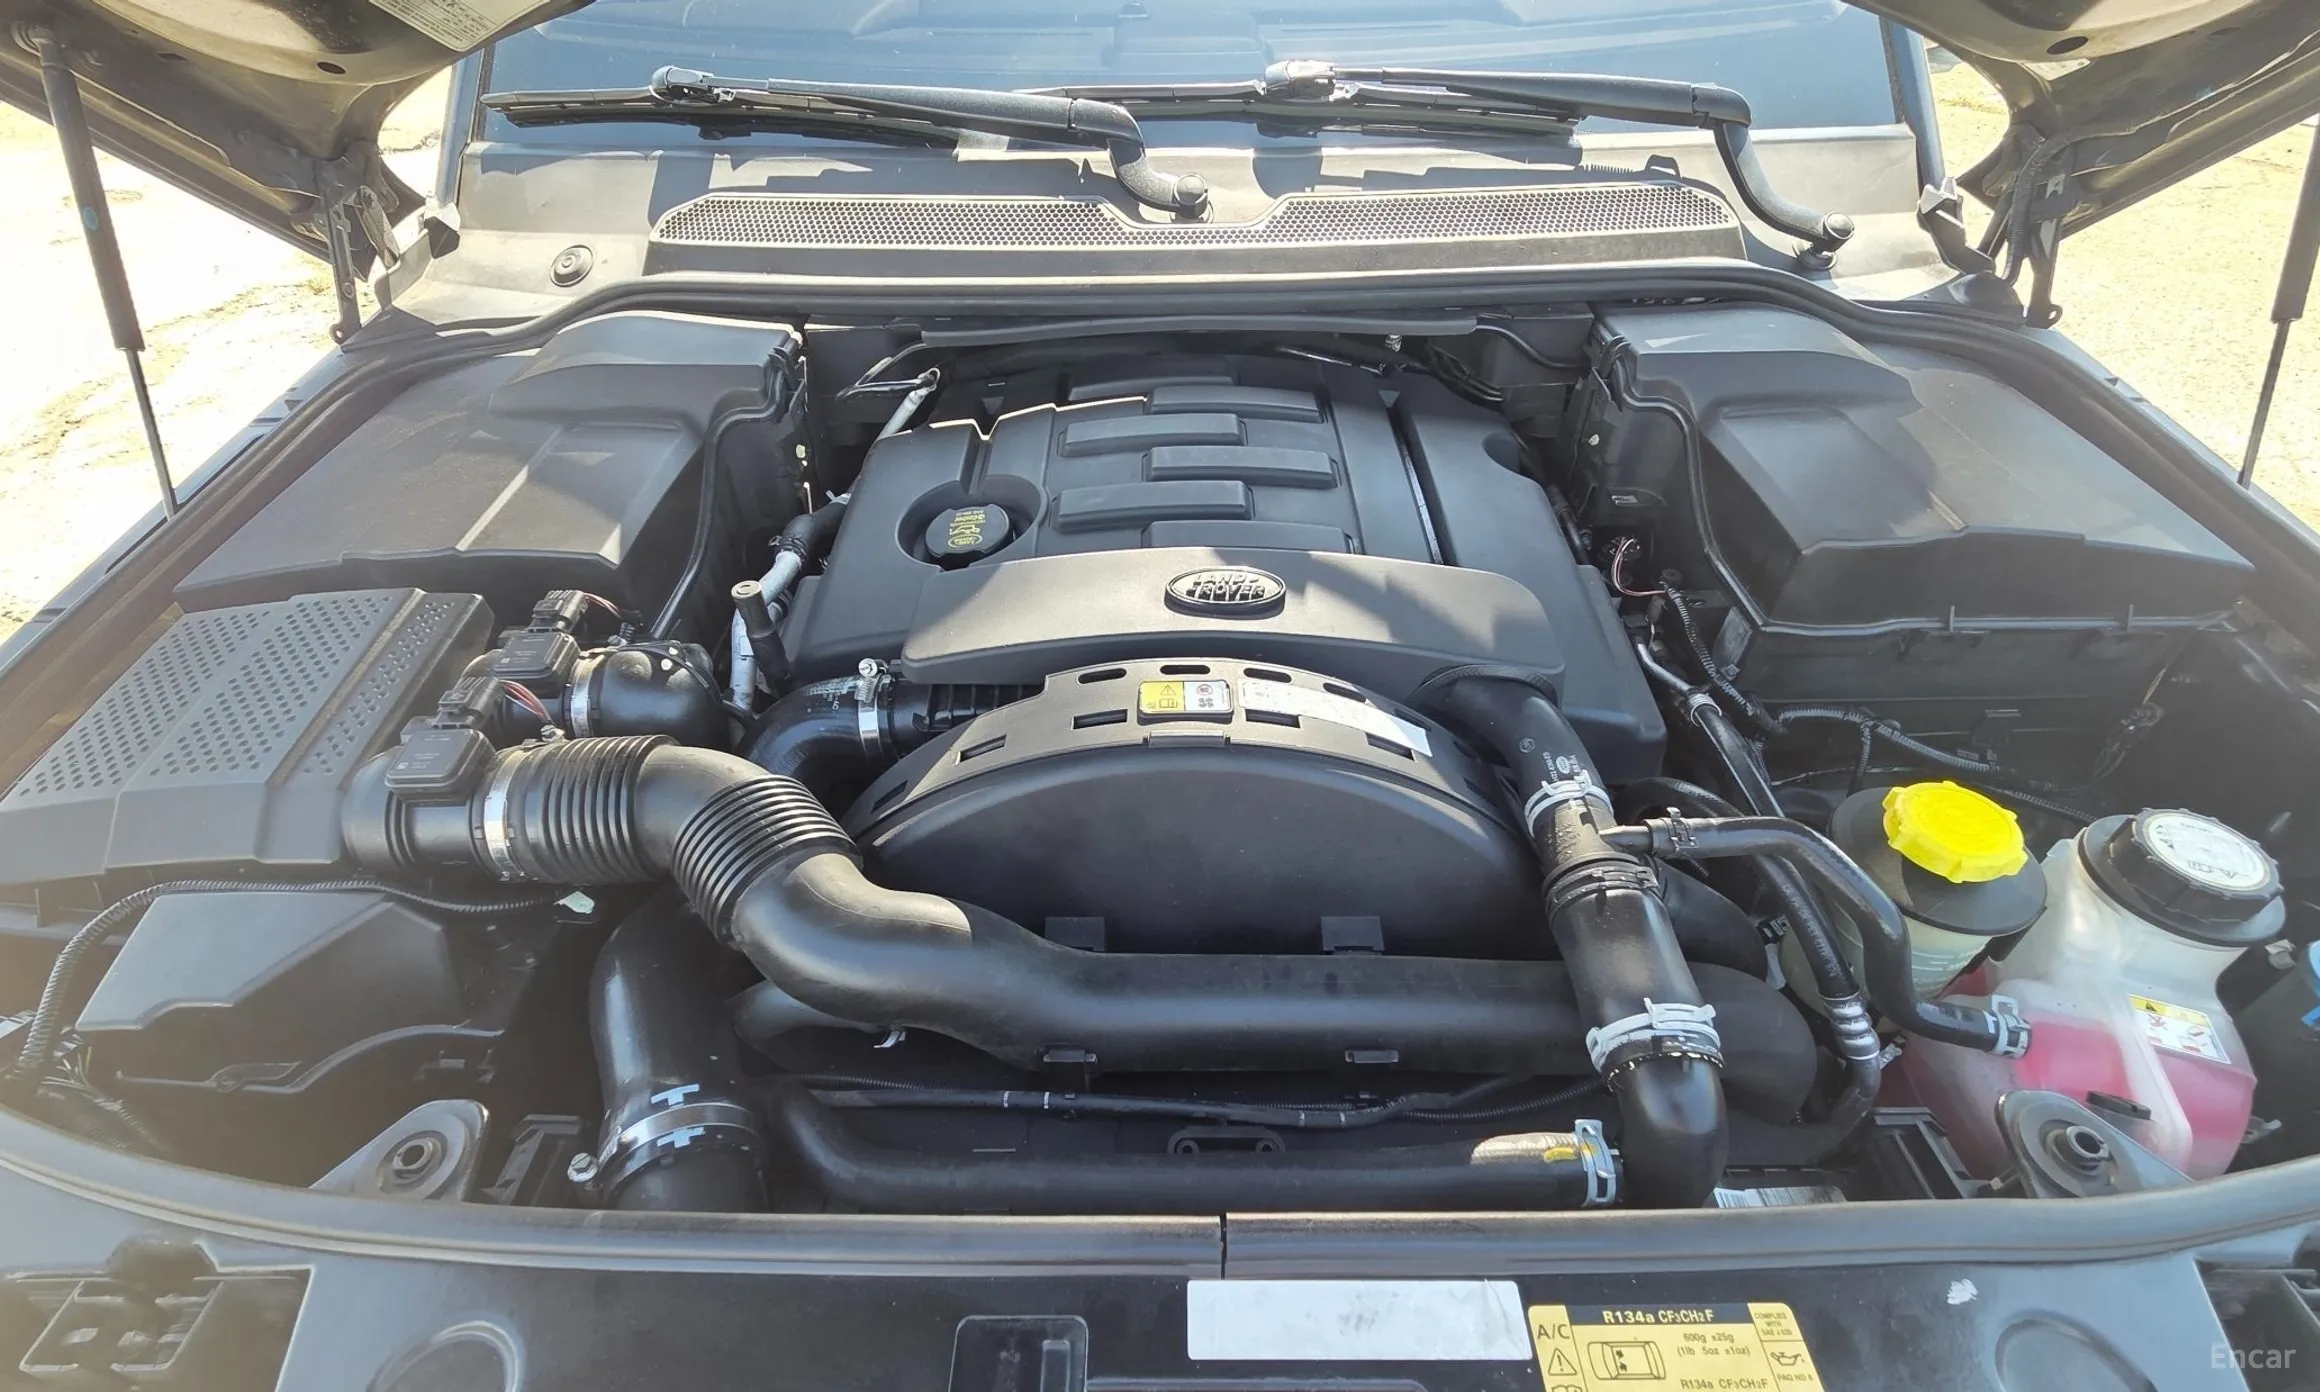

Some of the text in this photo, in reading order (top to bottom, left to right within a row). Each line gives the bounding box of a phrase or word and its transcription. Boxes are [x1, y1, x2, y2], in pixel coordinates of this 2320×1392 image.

[1199, 584, 1266, 599] ROVER
[1602, 1310, 1656, 1323] R134a
[1537, 1323, 1571, 1340] A/C
[1680, 1379, 1715, 1390] R134a
